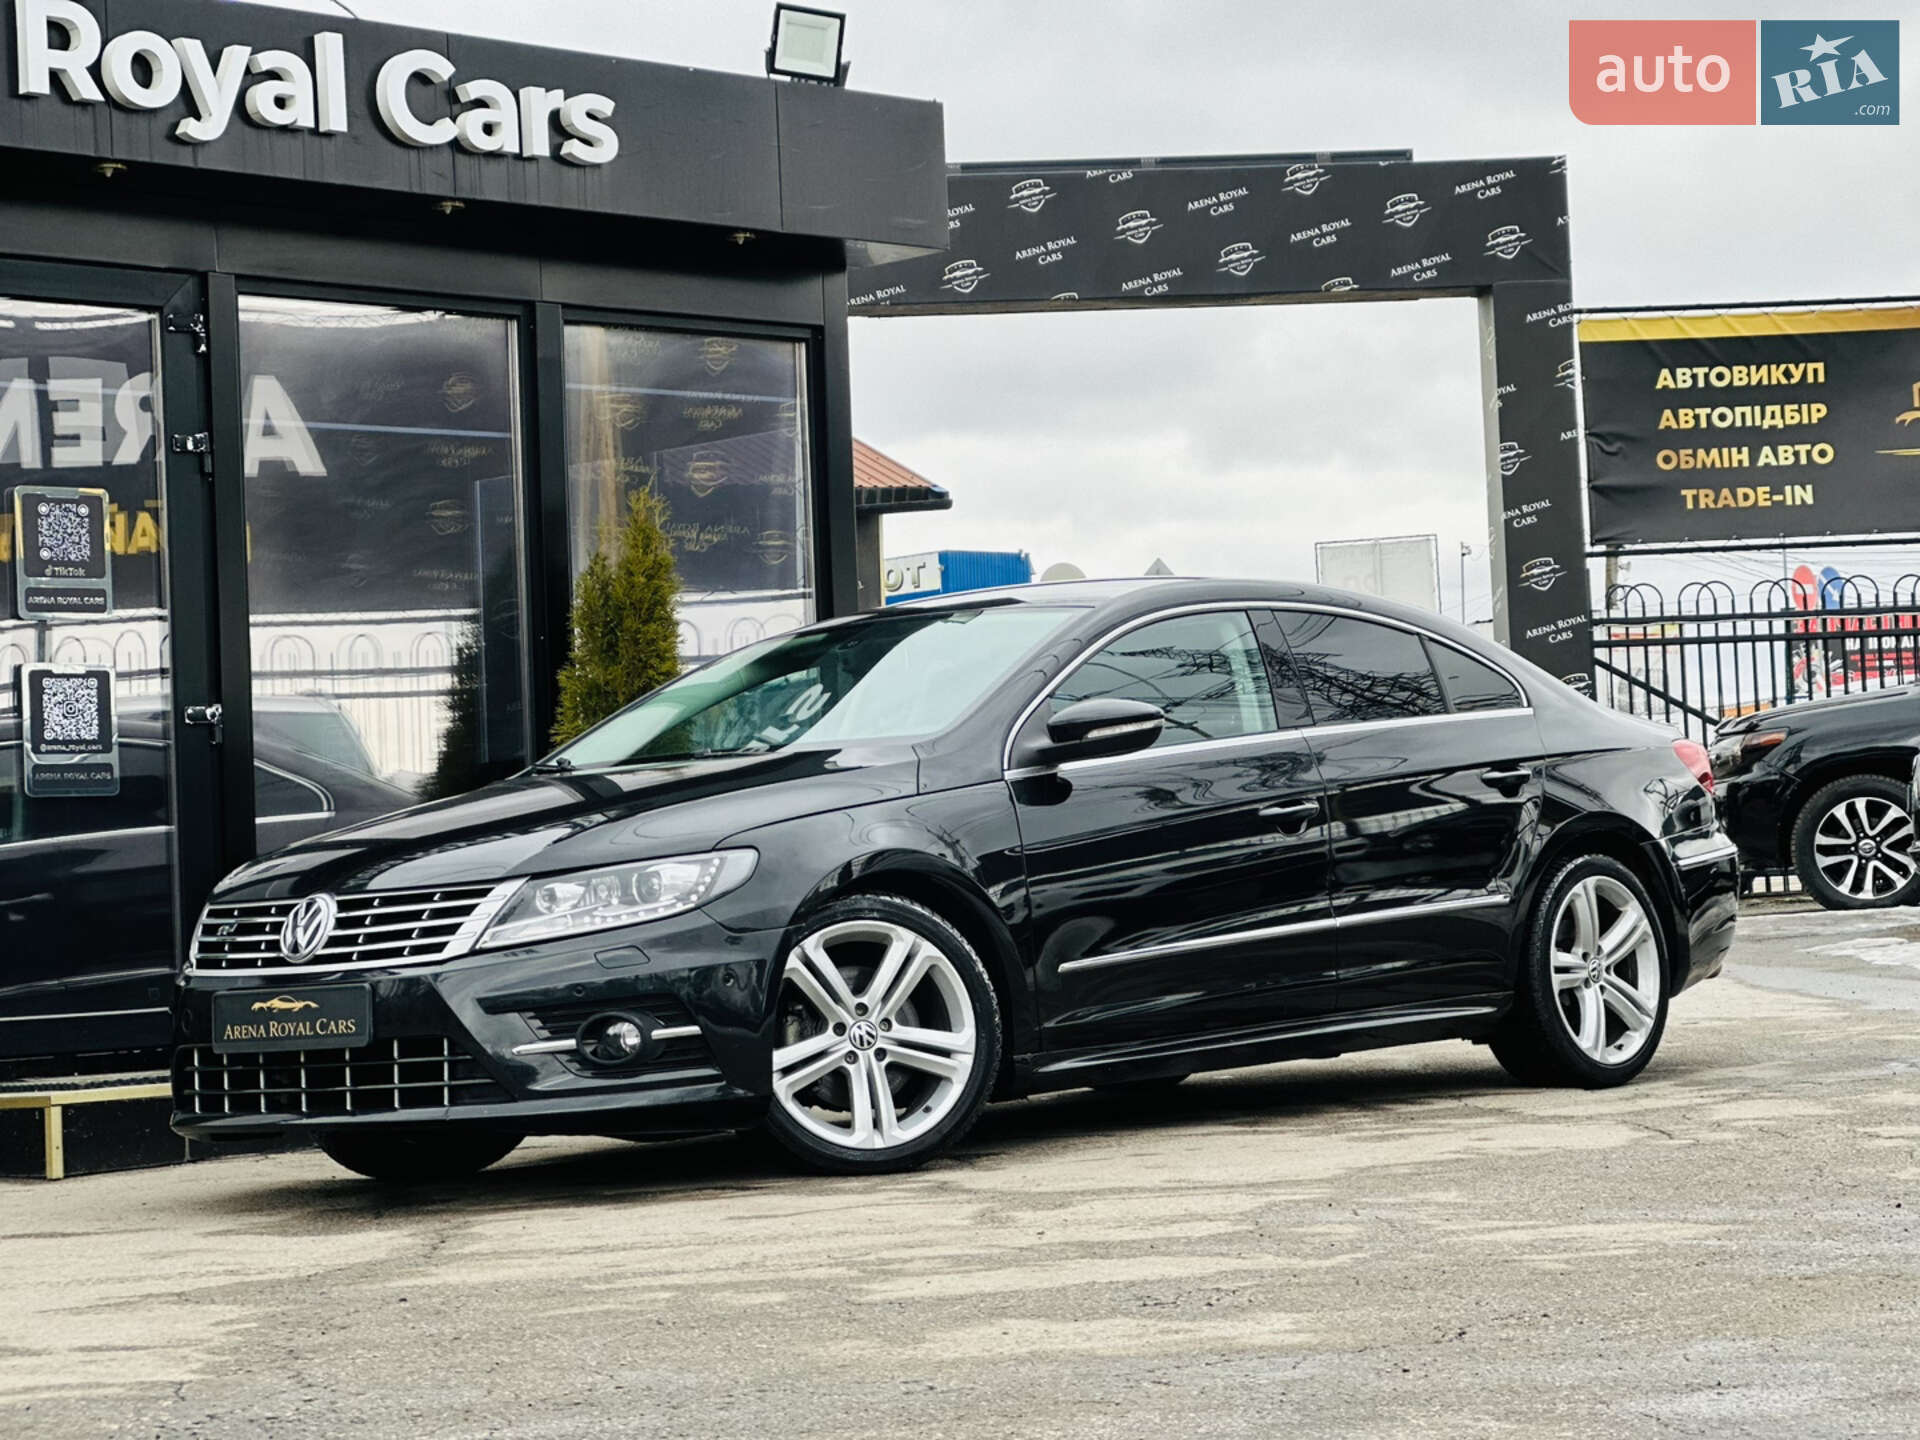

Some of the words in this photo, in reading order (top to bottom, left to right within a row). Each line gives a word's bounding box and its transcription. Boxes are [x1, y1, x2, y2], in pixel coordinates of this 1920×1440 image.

[16, 0, 348, 143] Royal
[375, 49, 620, 166] Cars
[1108, 169, 1133, 183] CARS
[1454, 178, 1485, 195] ARENA
[1486, 169, 1516, 185] ROYAL
[1187, 194, 1217, 211] ARENA
[1218, 186, 1248, 202] ROYAL
[1477, 186, 1502, 199] CARS
[1210, 202, 1234, 216] CARS
[1290, 227, 1320, 243] ARENA
[1321, 217, 1352, 233] ROYAL
[1312, 233, 1337, 248] CARS
[1015, 244, 1046, 260] ARENA
[1047, 235, 1077, 250] ROYAL
[1038, 252, 1063, 265] CARS
[1391, 262, 1421, 278] ARENA
[1421, 252, 1452, 268] ROYAL
[1413, 268, 1438, 282] CARS
[1121, 276, 1152, 292] ARENA
[1153, 267, 1183, 282] ROYAL
[1144, 283, 1169, 296] CARS
[876, 285, 906, 299] ROYAL
[1526, 307, 1557, 323] ARENA
[1655, 362, 1826, 389] АВТОВИКУП
[1657, 403, 1828, 430] АВТОПІДБІР
[1656, 446, 1749, 471] ОБМІН
[1757, 442, 1834, 467] АВТО
[1521, 499, 1552, 513] ROYAL
[1681, 484, 1814, 509] TRADE-IN
[1513, 514, 1538, 528] CARS
[1526, 623, 1557, 639] ARENA
[1557, 614, 1588, 629] ROYAL
[1548, 630, 1573, 644] CARS
[223, 1023, 266, 1040] ARENA
[269, 1020, 314, 1038] ROYAL
[315, 1018, 357, 1035] CARS
